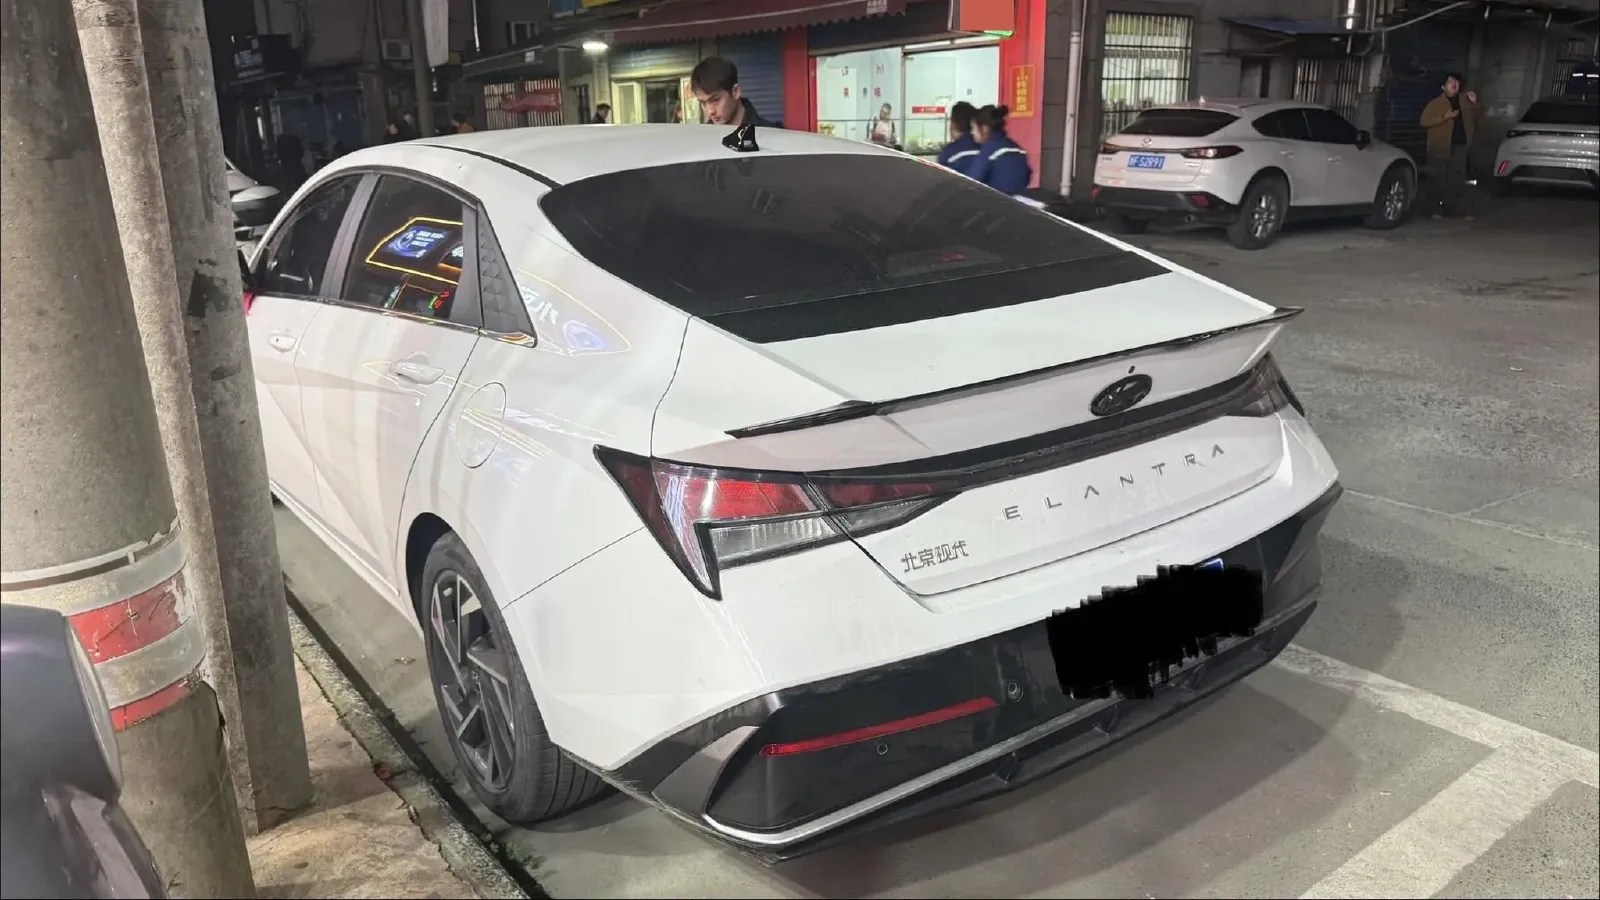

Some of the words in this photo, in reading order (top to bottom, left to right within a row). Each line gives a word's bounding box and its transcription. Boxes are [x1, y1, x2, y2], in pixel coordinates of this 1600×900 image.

[1002, 444, 1225, 521] ELANTRA
[901, 540, 969, 573] 北京现代
